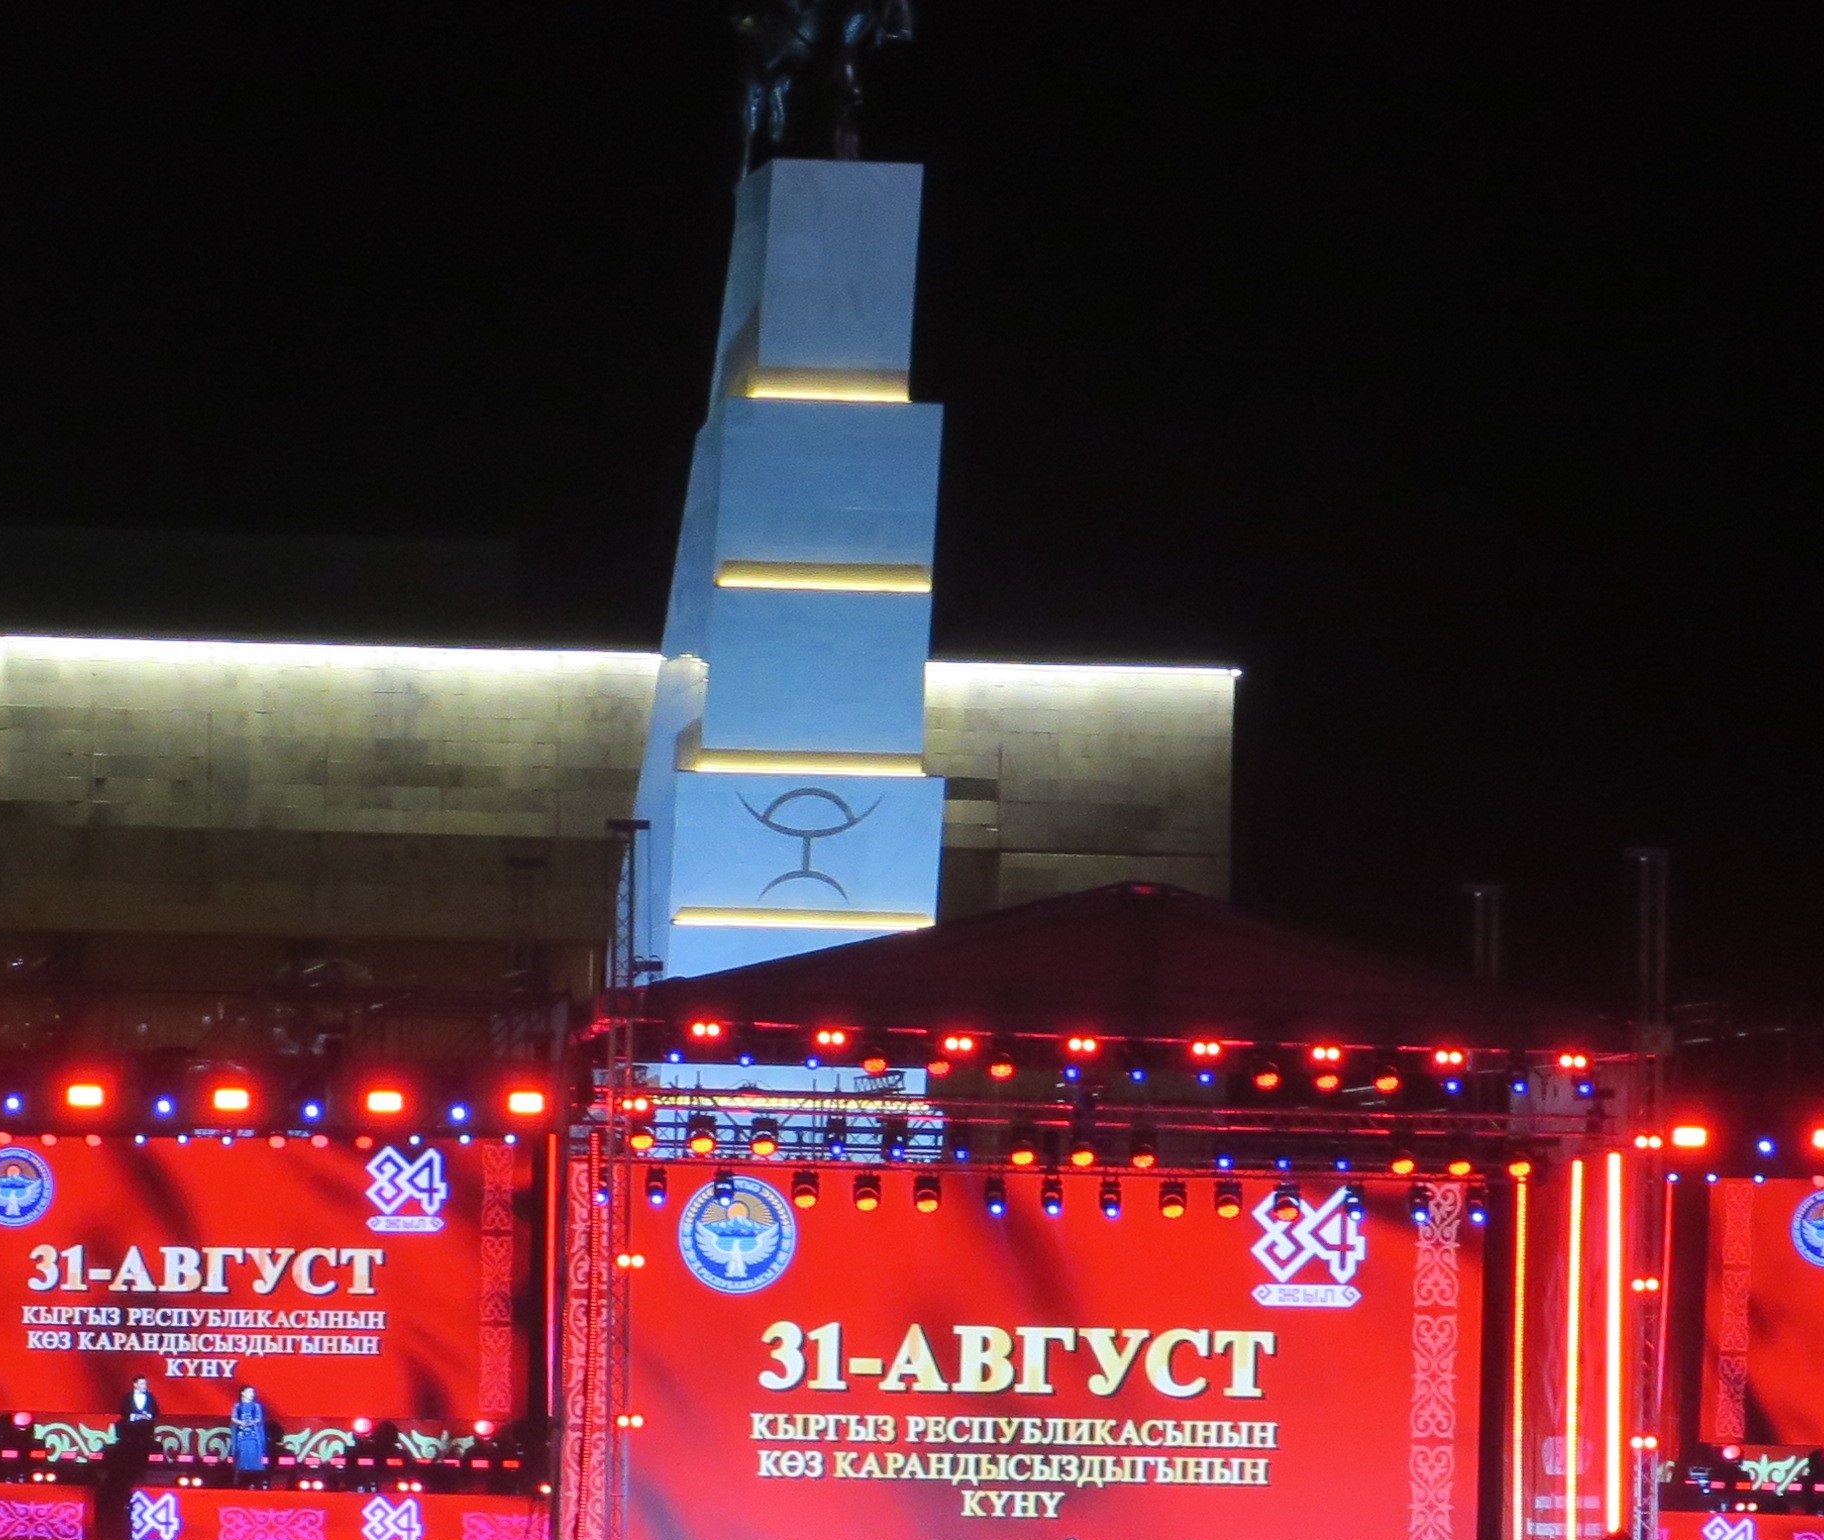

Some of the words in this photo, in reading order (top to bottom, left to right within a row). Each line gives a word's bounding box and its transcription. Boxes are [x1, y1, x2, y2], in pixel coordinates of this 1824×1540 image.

[365, 1145, 448, 1215] 34
[27, 1244, 384, 1295] 31-АВГУСТ
[21, 1305, 122, 1326] КЫРГЫЗ
[127, 1307, 386, 1331] РЕСПУБЛИКАСЫНЫН
[26, 1330, 73, 1350] КӨЗ
[77, 1331, 381, 1356] КАРАНДЫСЫЗДЫГЫНЫН
[758, 1321, 1275, 1398] 31-АВГУСТ
[165, 1358, 238, 1378] КҮНҮ
[749, 1413, 895, 1443] КЫРГЫЗ
[904, 1415, 1279, 1449] РЕСПУБЛИКАСЫНЫН
[757, 1449, 824, 1479] КӨЗ
[832, 1451, 1270, 1487] КАРАНДЫСЫЗДЫГЫНЫН
[960, 1489, 1065, 1518] КҮНҮ
